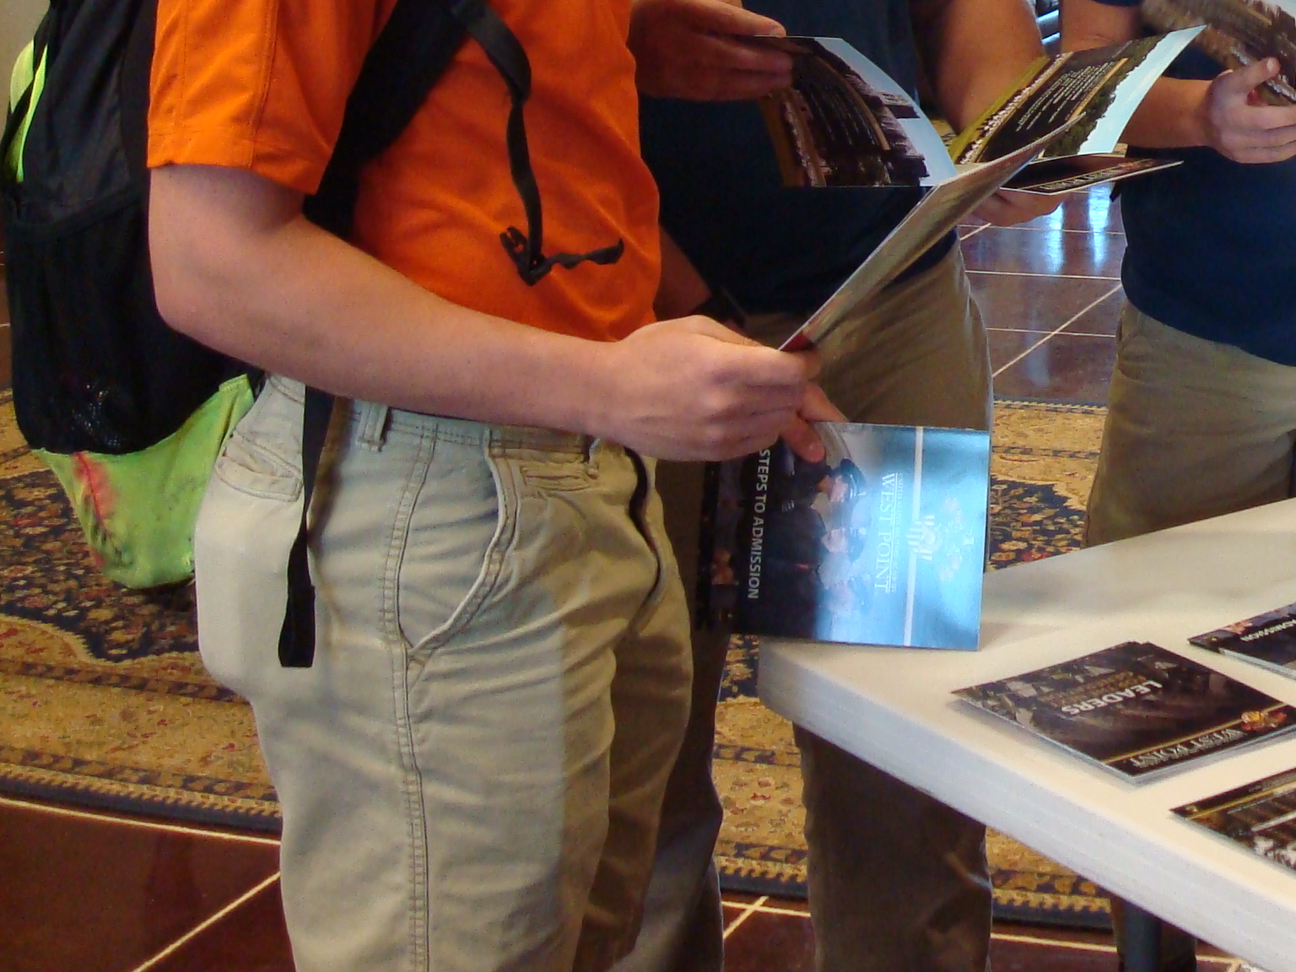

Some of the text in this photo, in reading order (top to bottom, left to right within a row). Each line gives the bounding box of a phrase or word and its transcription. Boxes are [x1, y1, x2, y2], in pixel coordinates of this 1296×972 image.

[748, 449, 771, 600] STEPS TO ADMISSION
[874, 473, 895, 594] WEST POINT
[1061, 679, 1163, 716] LEADERS
[1130, 743, 1189, 765] POINT
